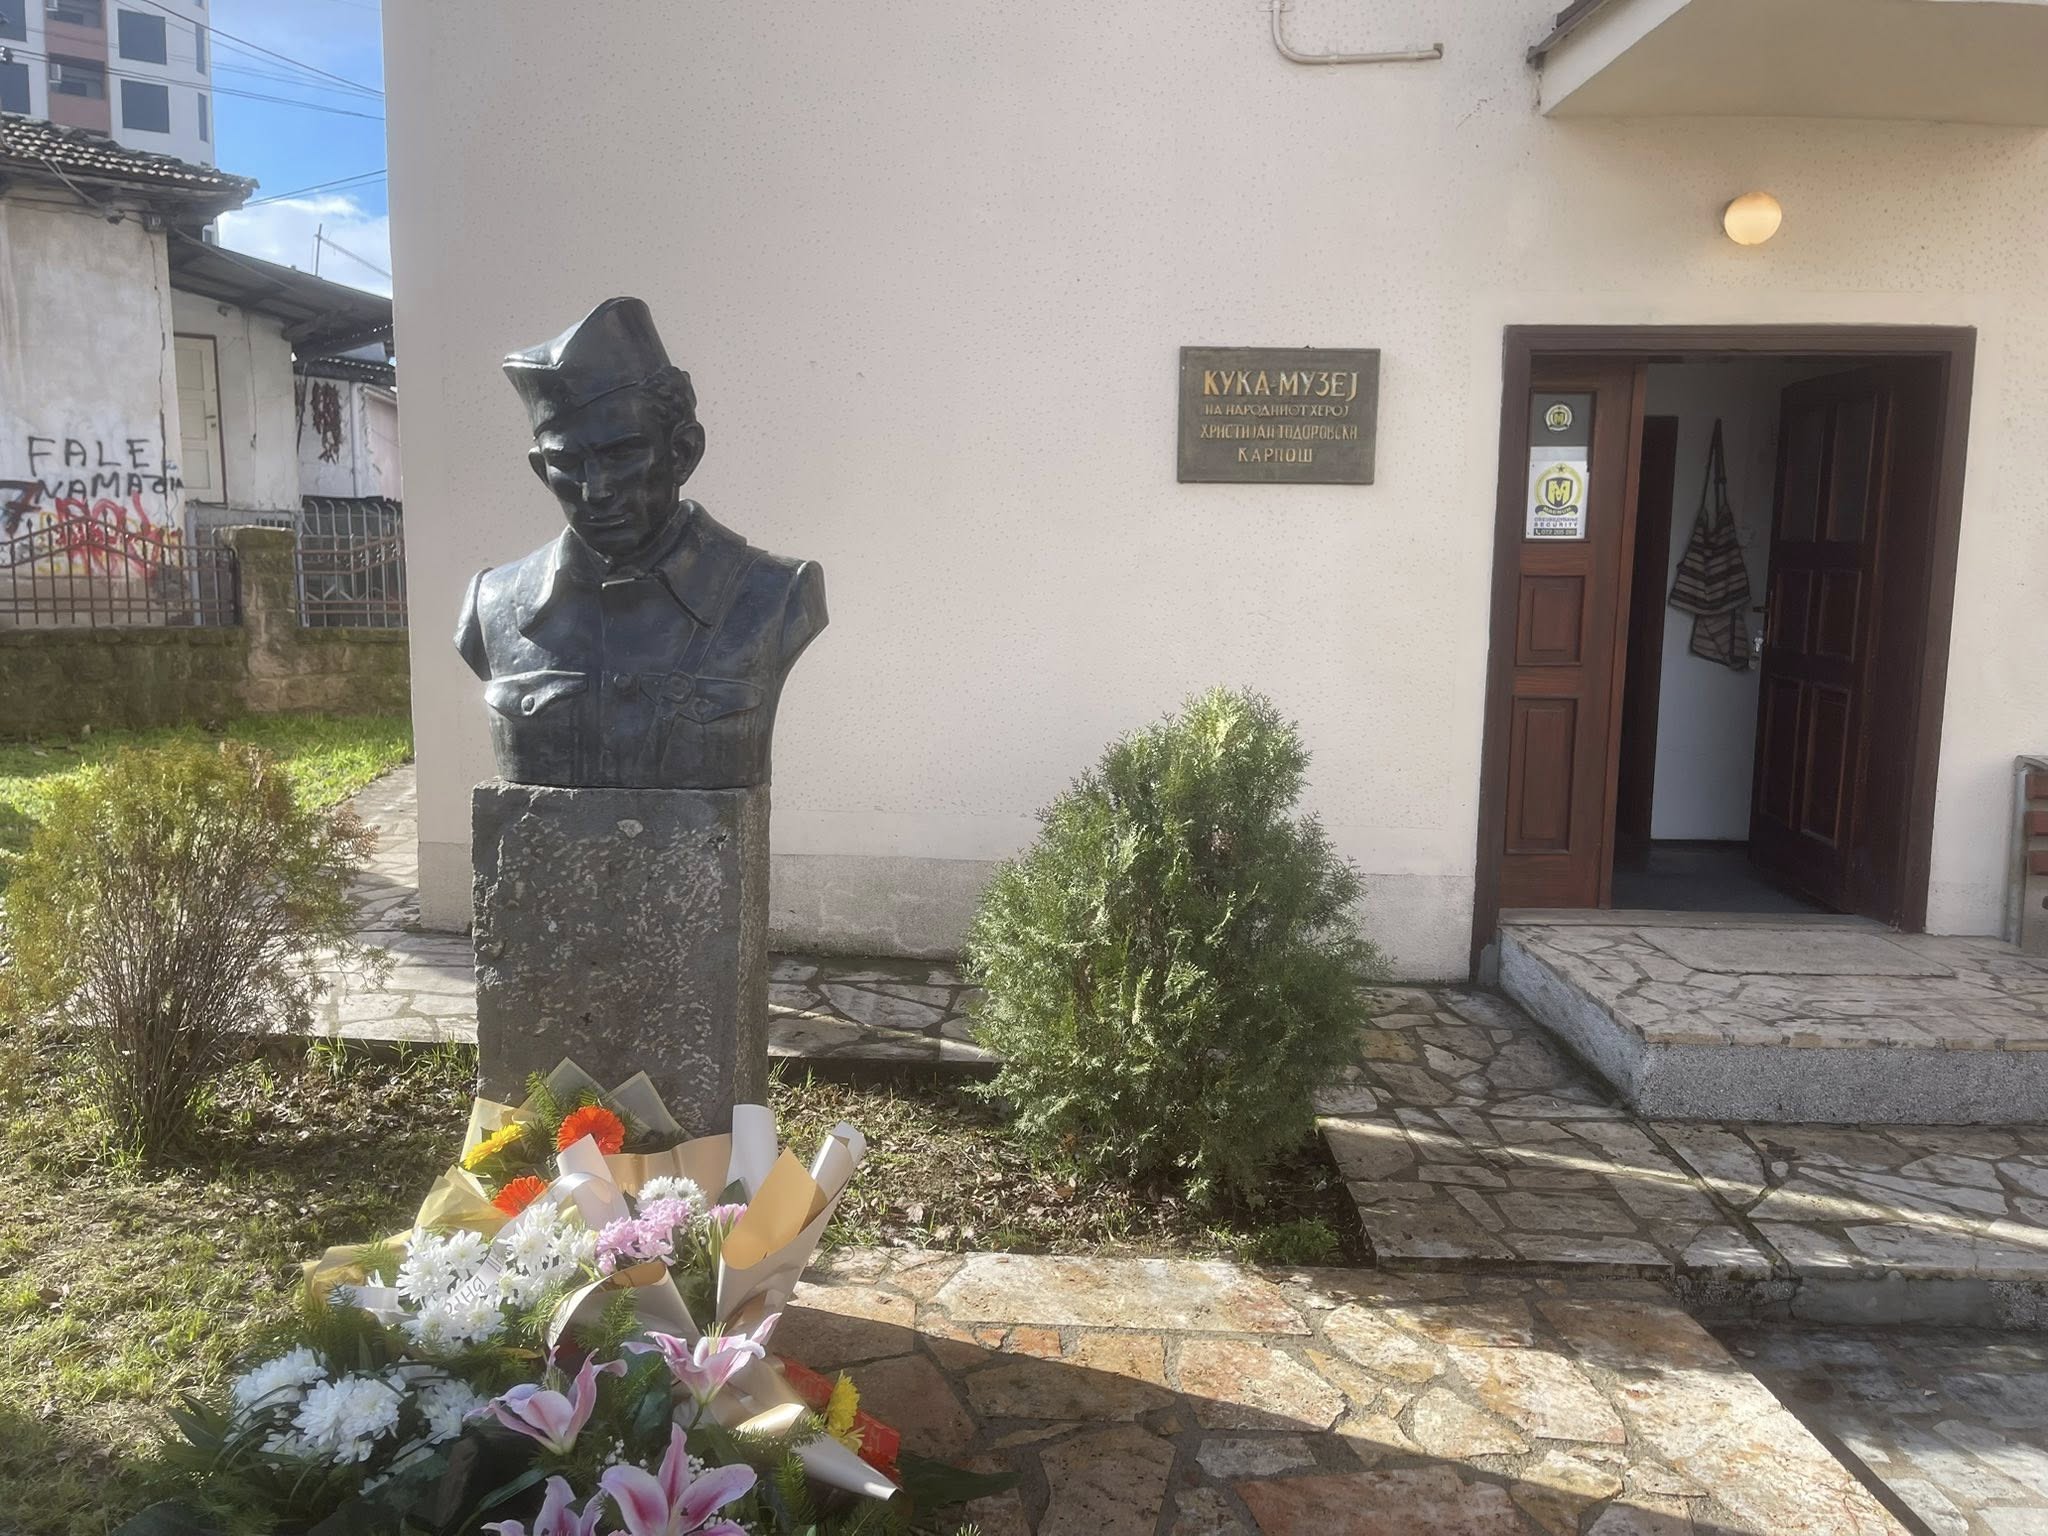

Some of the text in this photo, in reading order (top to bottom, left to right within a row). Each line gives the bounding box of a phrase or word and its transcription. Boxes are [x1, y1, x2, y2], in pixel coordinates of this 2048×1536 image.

[1205, 404, 1223, 416] НА
[1310, 404, 1350, 417] ХЕРОЈ
[1200, 423, 1276, 440] ХРИСТИЈАН
[28, 436, 151, 477] FALE
[1238, 447, 1313, 463] КАРПОШ
